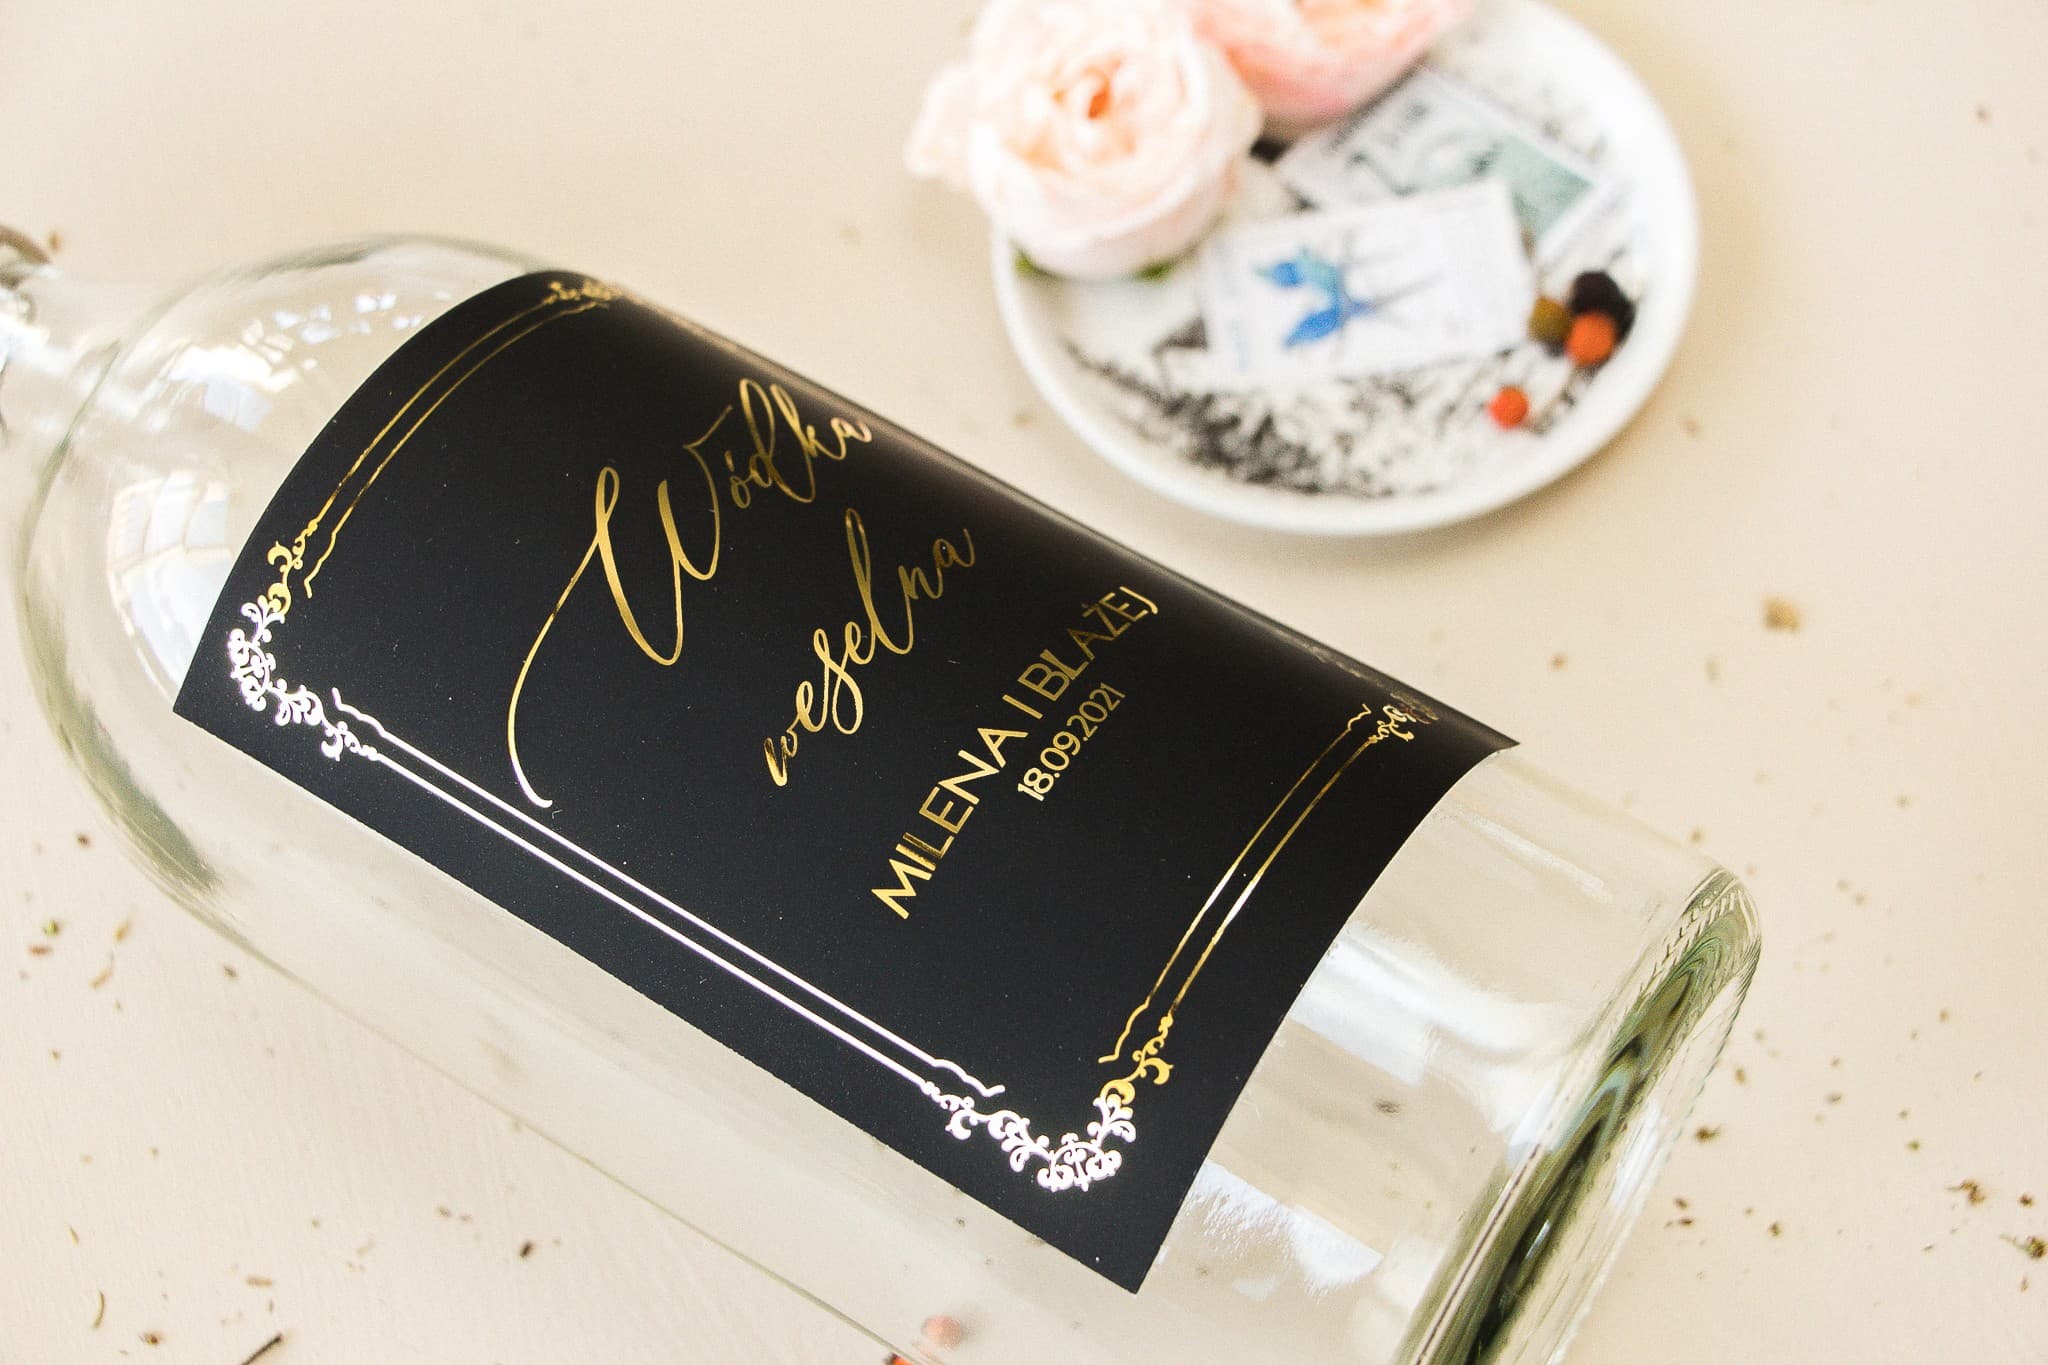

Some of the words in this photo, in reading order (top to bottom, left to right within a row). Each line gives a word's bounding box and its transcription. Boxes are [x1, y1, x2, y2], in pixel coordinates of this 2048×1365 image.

[507, 378, 872, 808] Wódka
[763, 508, 975, 787] weselna
[871, 727, 1028, 919] MILENA
[1002, 694, 1043, 720] I
[1017, 682, 1126, 801] 18.09.2021
